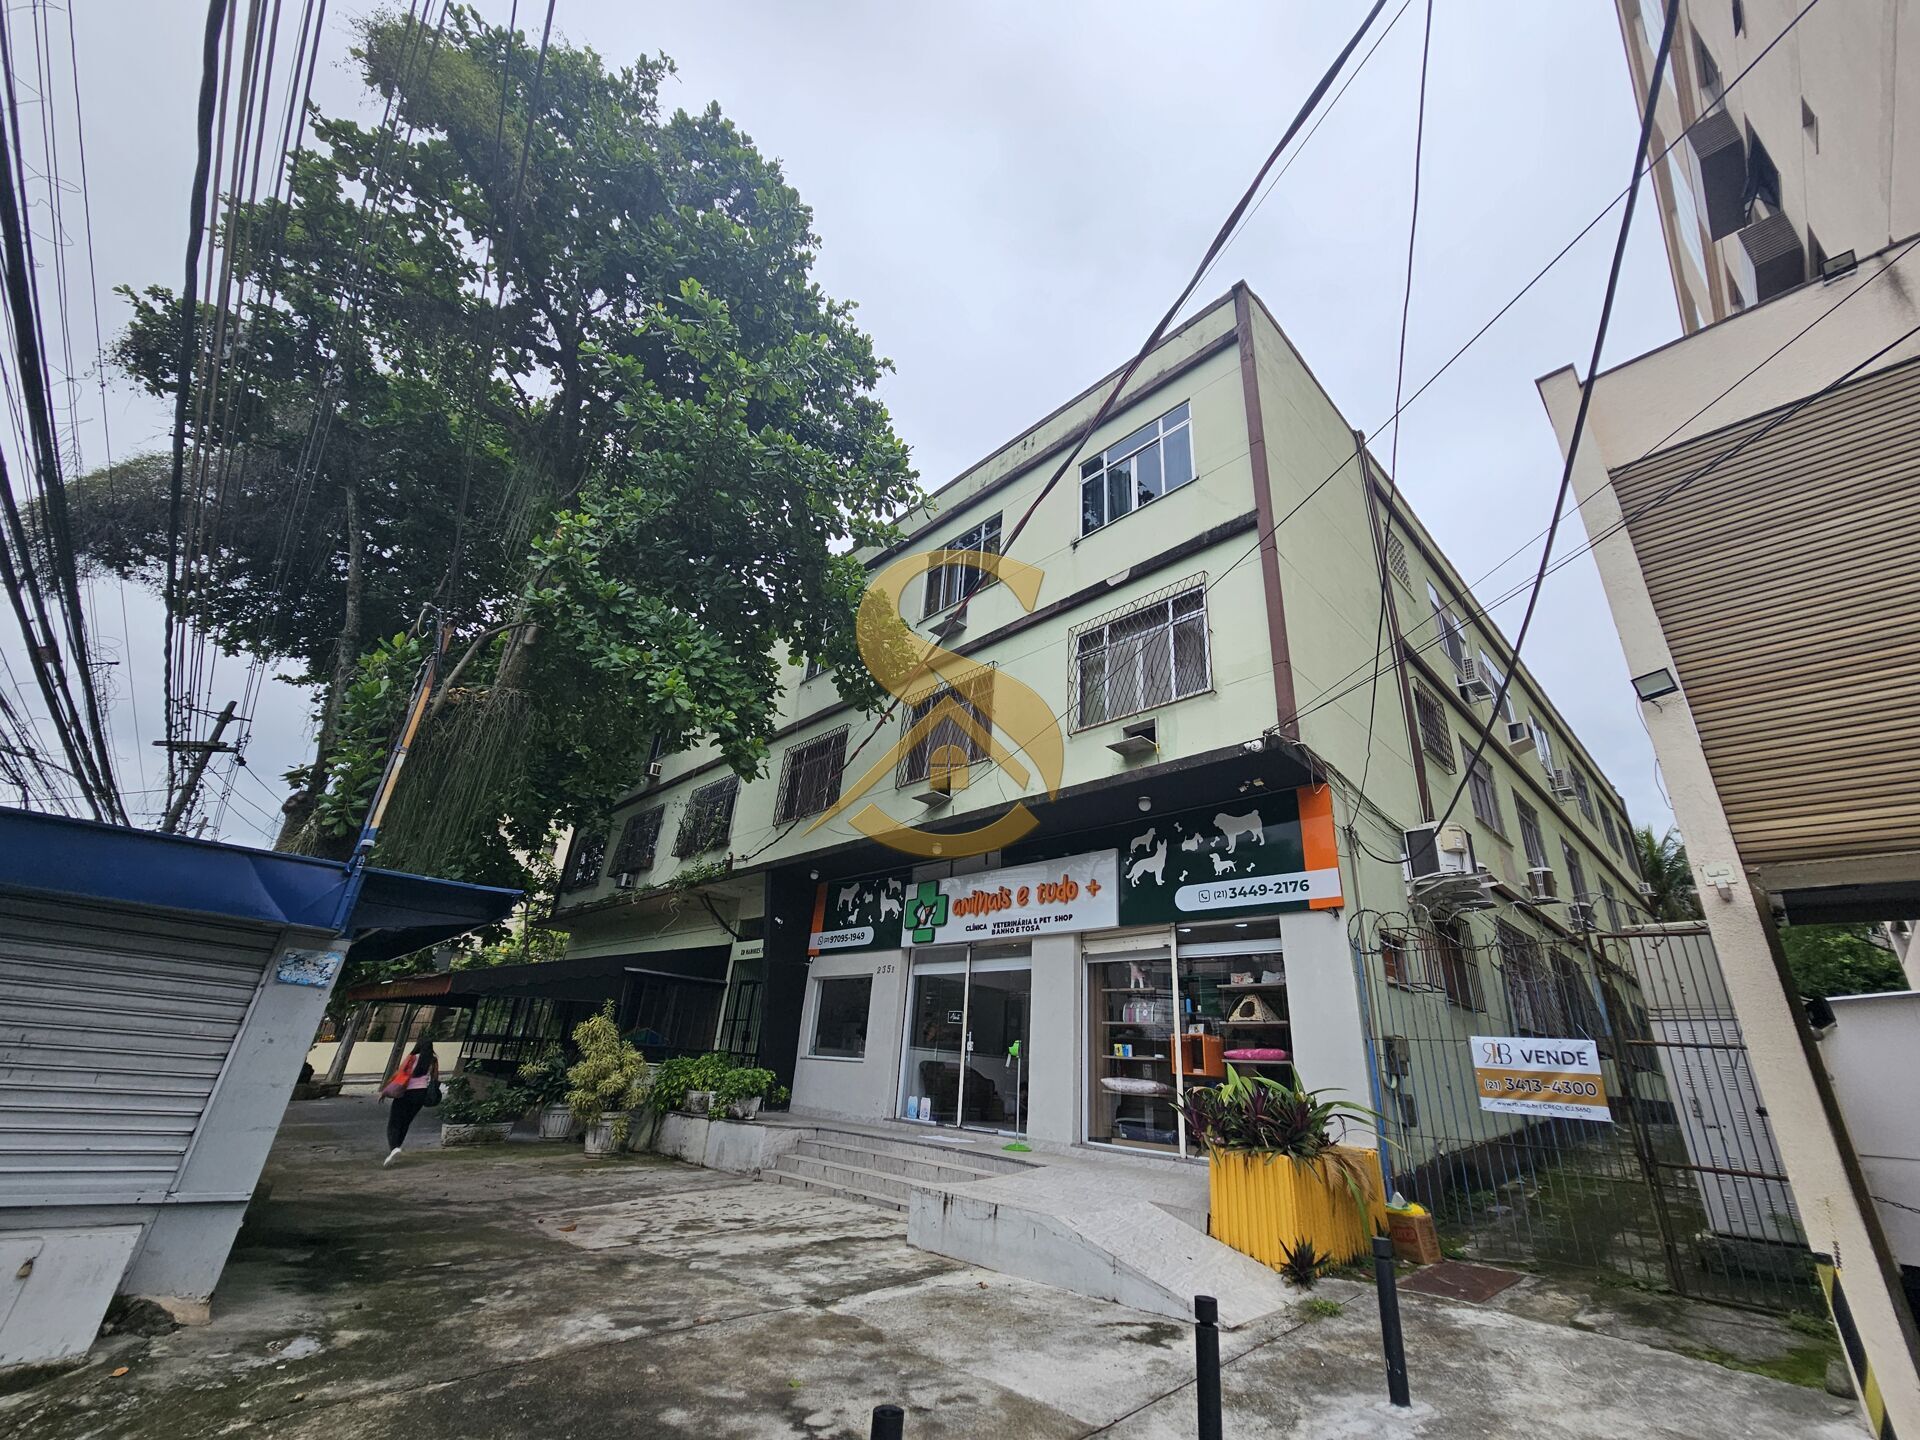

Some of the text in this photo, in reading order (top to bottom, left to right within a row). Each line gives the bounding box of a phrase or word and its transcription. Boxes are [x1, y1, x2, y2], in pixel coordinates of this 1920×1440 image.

[1016, 885, 1030, 907] e
[1036, 873, 1079, 905] tudo
[1213, 879, 1310, 900] (21) 3449-2176
[965, 922, 988, 932] CLÍNICA
[992, 917, 1033, 930] VETERINÁRIA
[1039, 915, 1052, 924] PET
[1054, 913, 1073, 923] SHOP
[991, 926, 1015, 936] BANHO
[1021, 924, 1041, 933] TOSA
[829, 931, 866, 944] 97095-1949
[1519, 1049, 1589, 1066] VENDE
[1485, 1078, 1598, 1097] (21) 3413-4300
